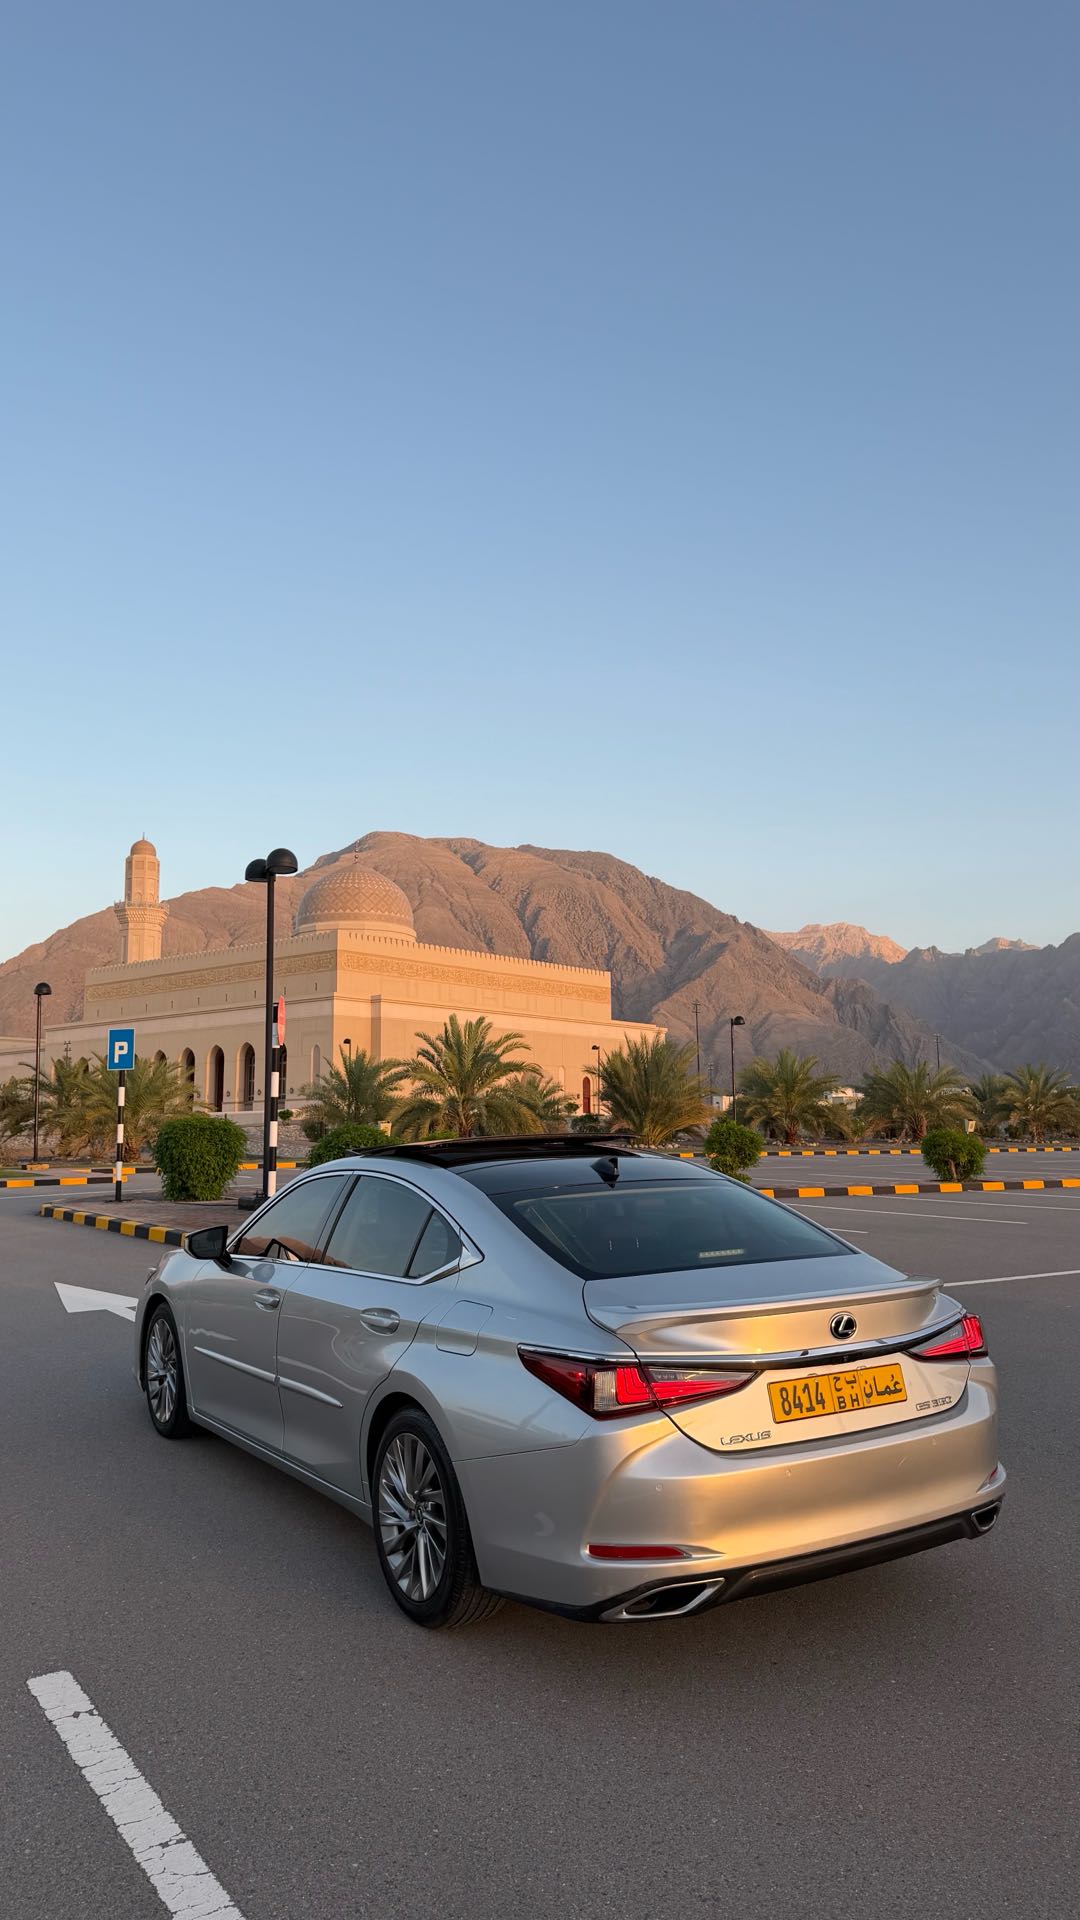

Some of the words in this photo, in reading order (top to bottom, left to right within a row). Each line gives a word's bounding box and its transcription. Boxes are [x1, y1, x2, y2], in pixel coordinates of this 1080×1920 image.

[114, 1041, 128, 1064] P
[780, 1382, 826, 1416] 8414
[720, 1430, 771, 1445] LEXUS
